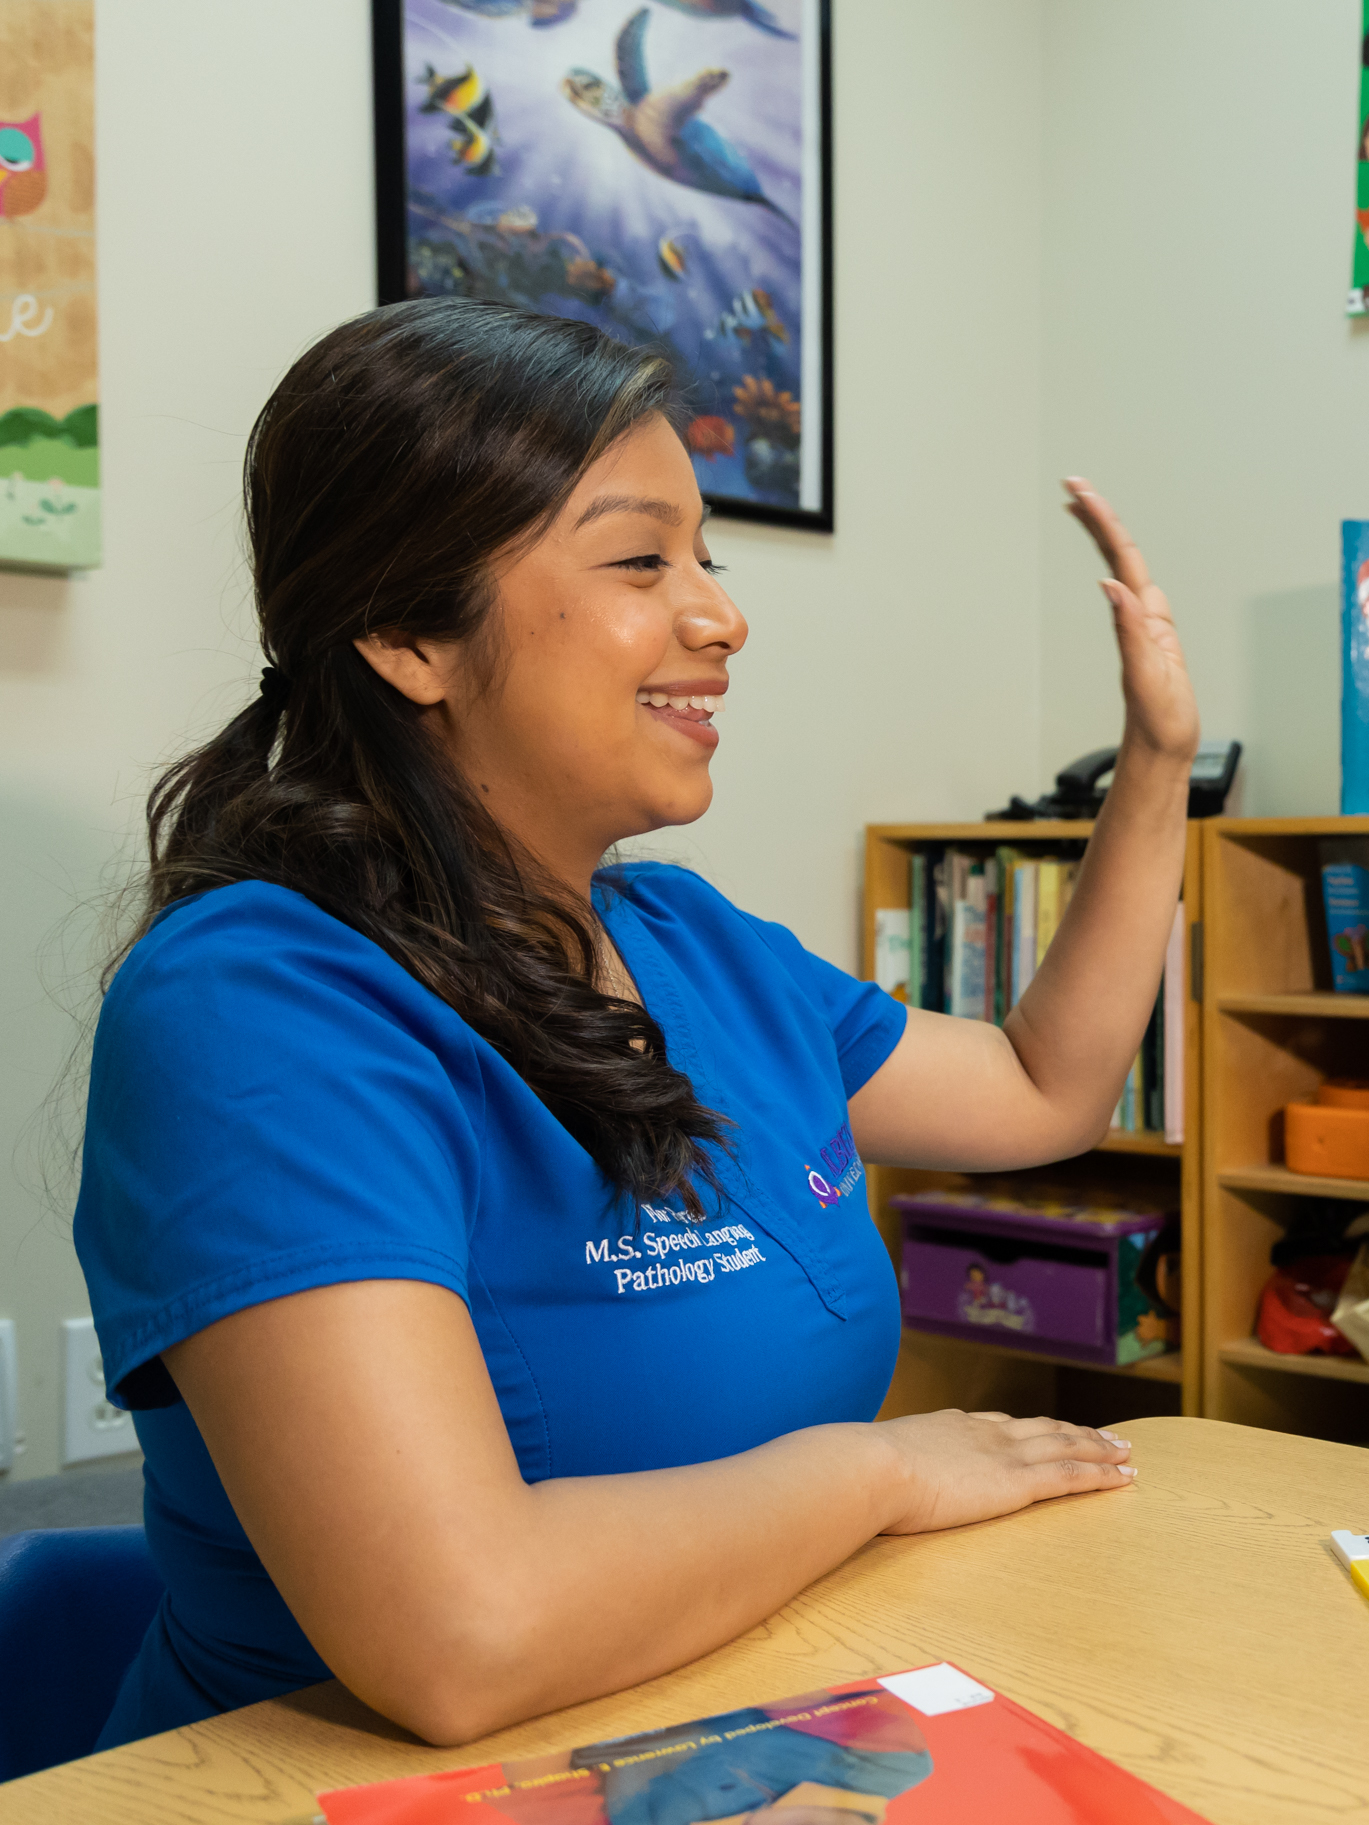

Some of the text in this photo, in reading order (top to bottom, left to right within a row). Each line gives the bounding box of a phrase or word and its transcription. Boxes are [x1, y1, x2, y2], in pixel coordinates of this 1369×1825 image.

[585, 1235, 642, 1265] M.S.
[643, 1226, 703, 1260] Speech
[613, 1243, 767, 1294] Pathology Student
[813, 1695, 879, 1718] Concept
[699, 1734, 723, 1746] by
[723, 1711, 813, 1741] Developed
[612, 1740, 697, 1768] Lawrence
